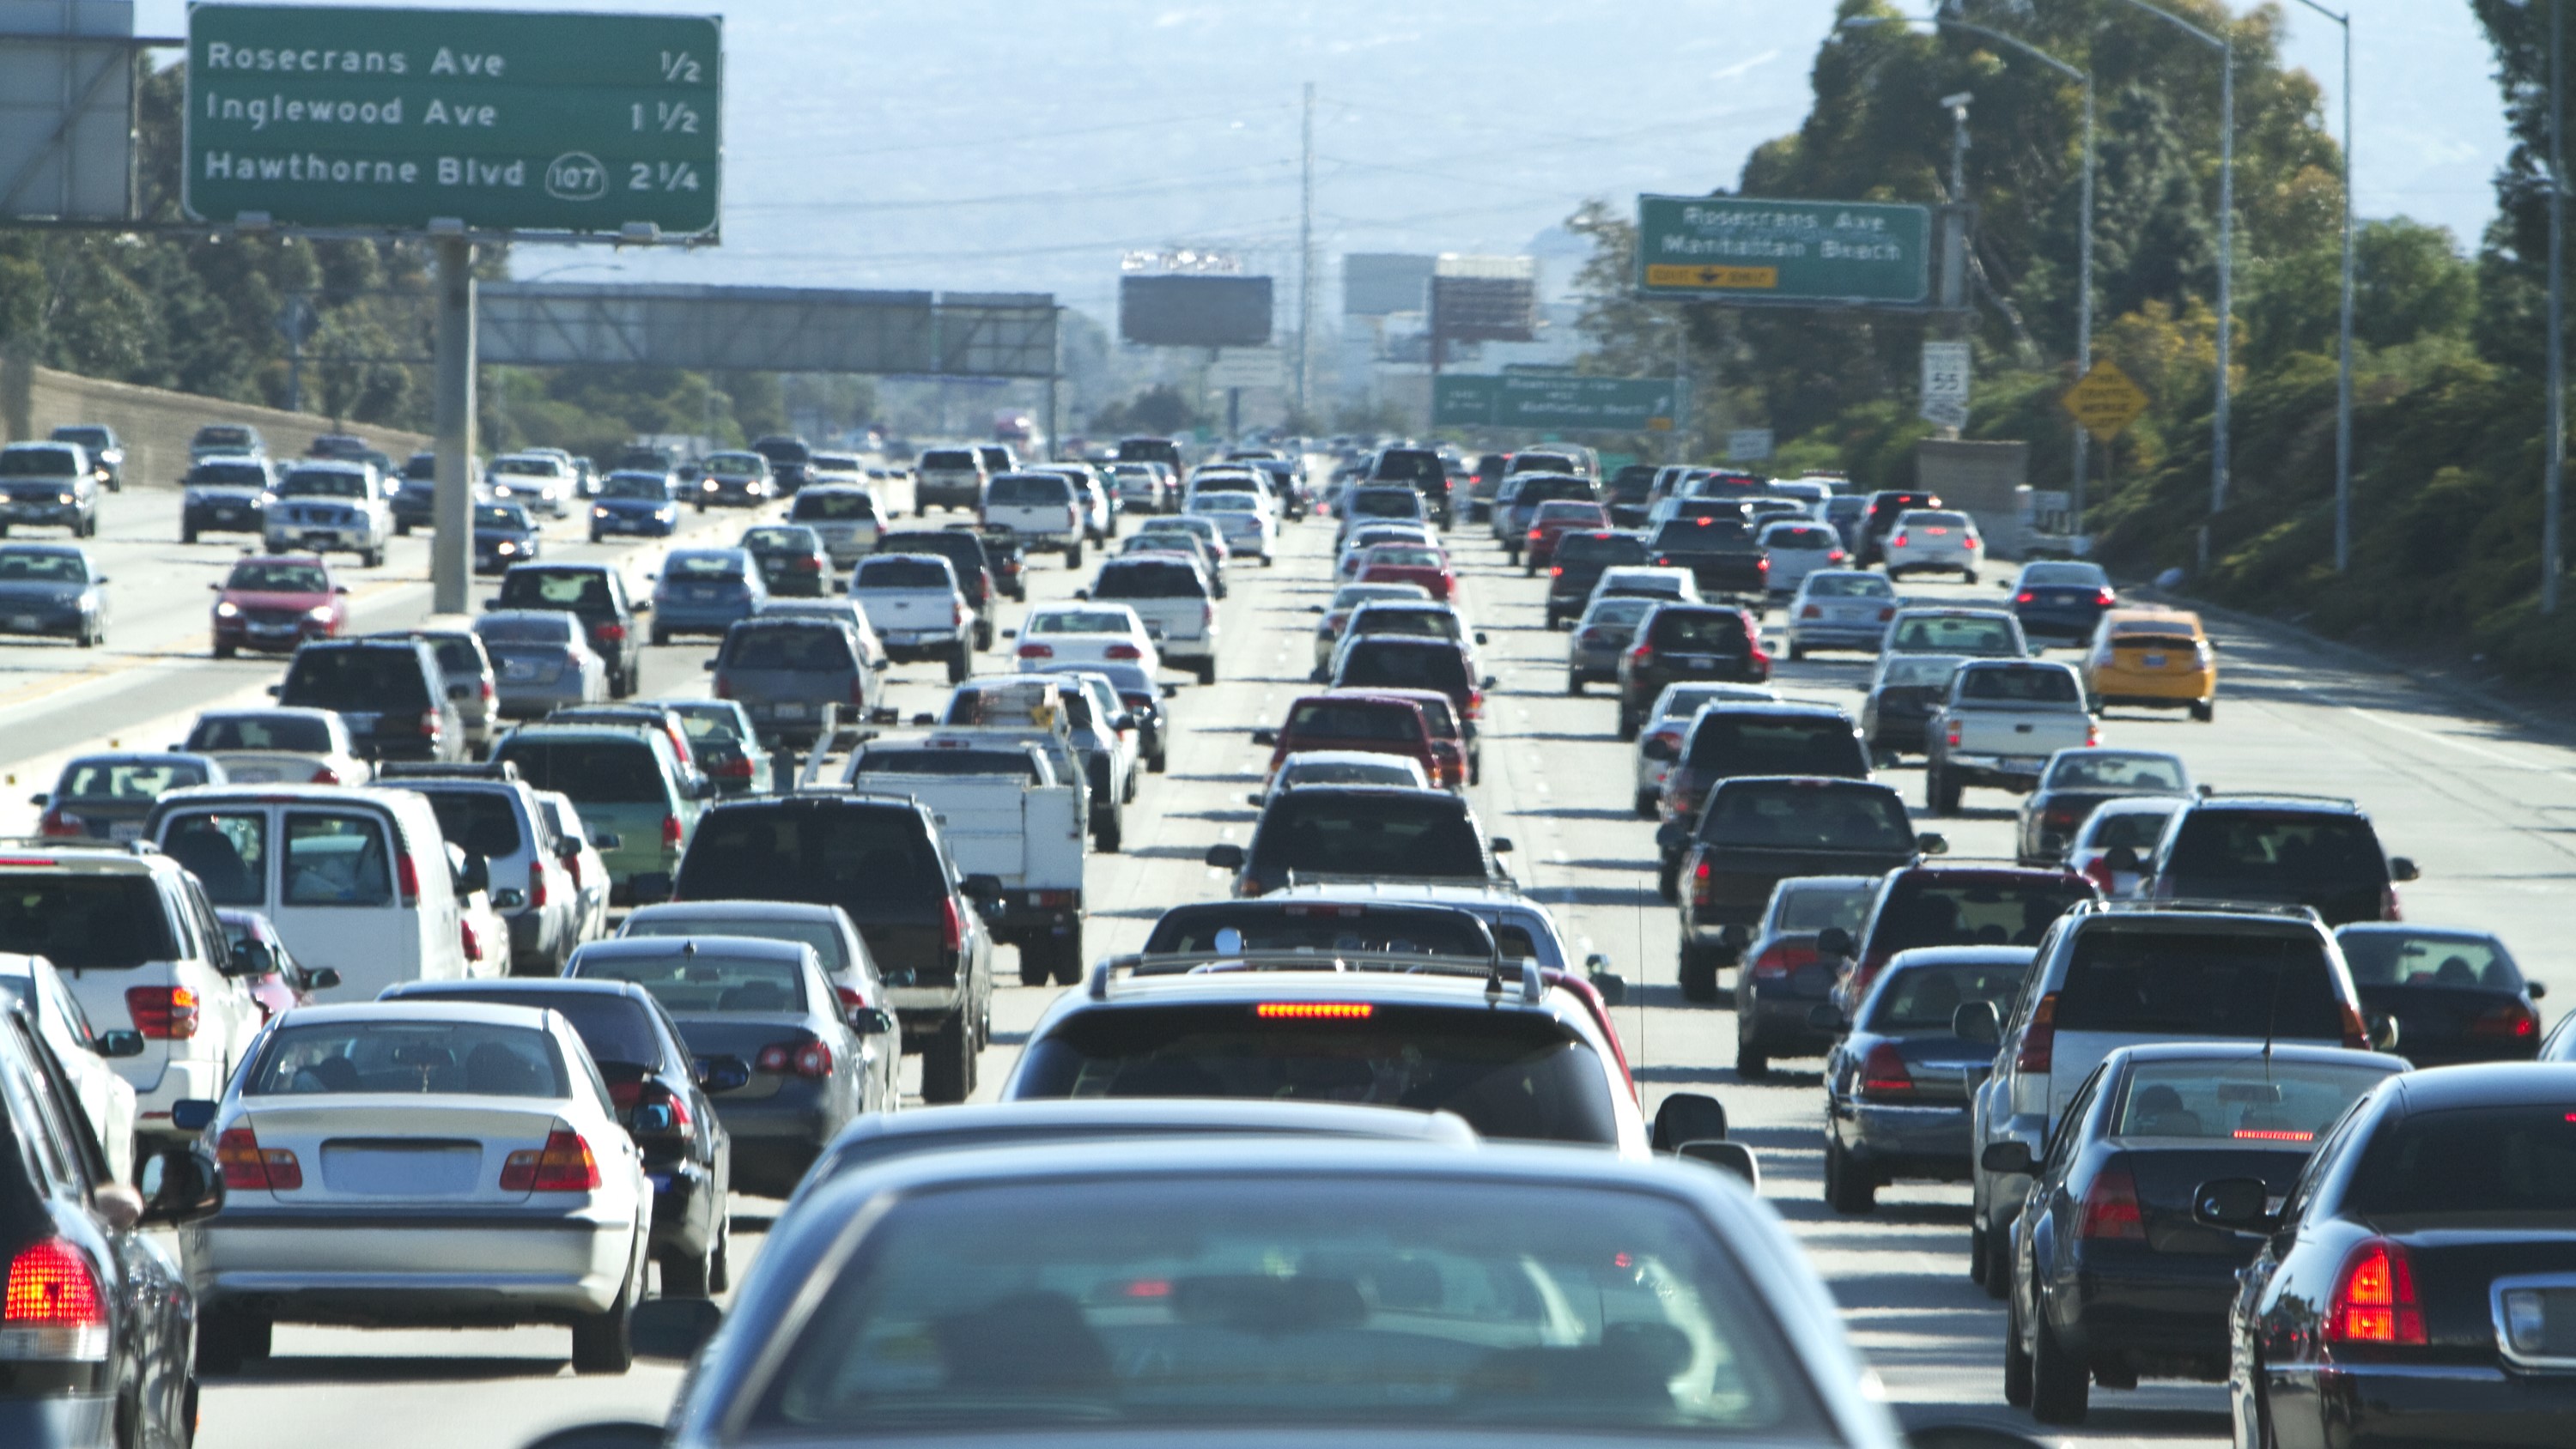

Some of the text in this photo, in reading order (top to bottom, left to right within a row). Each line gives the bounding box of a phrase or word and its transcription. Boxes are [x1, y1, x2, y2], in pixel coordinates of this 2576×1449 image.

[208, 42, 408, 74] Rosecrans
[429, 46, 506, 76] Ave
[207, 92, 403, 130] Inglewood
[424, 99, 497, 126] Ave
[206, 150, 418, 183] Hawthorne
[437, 156, 525, 186] Blvd
[555, 167, 597, 188] 107
[1683, 206, 1885, 231] Rosecrans Ave
